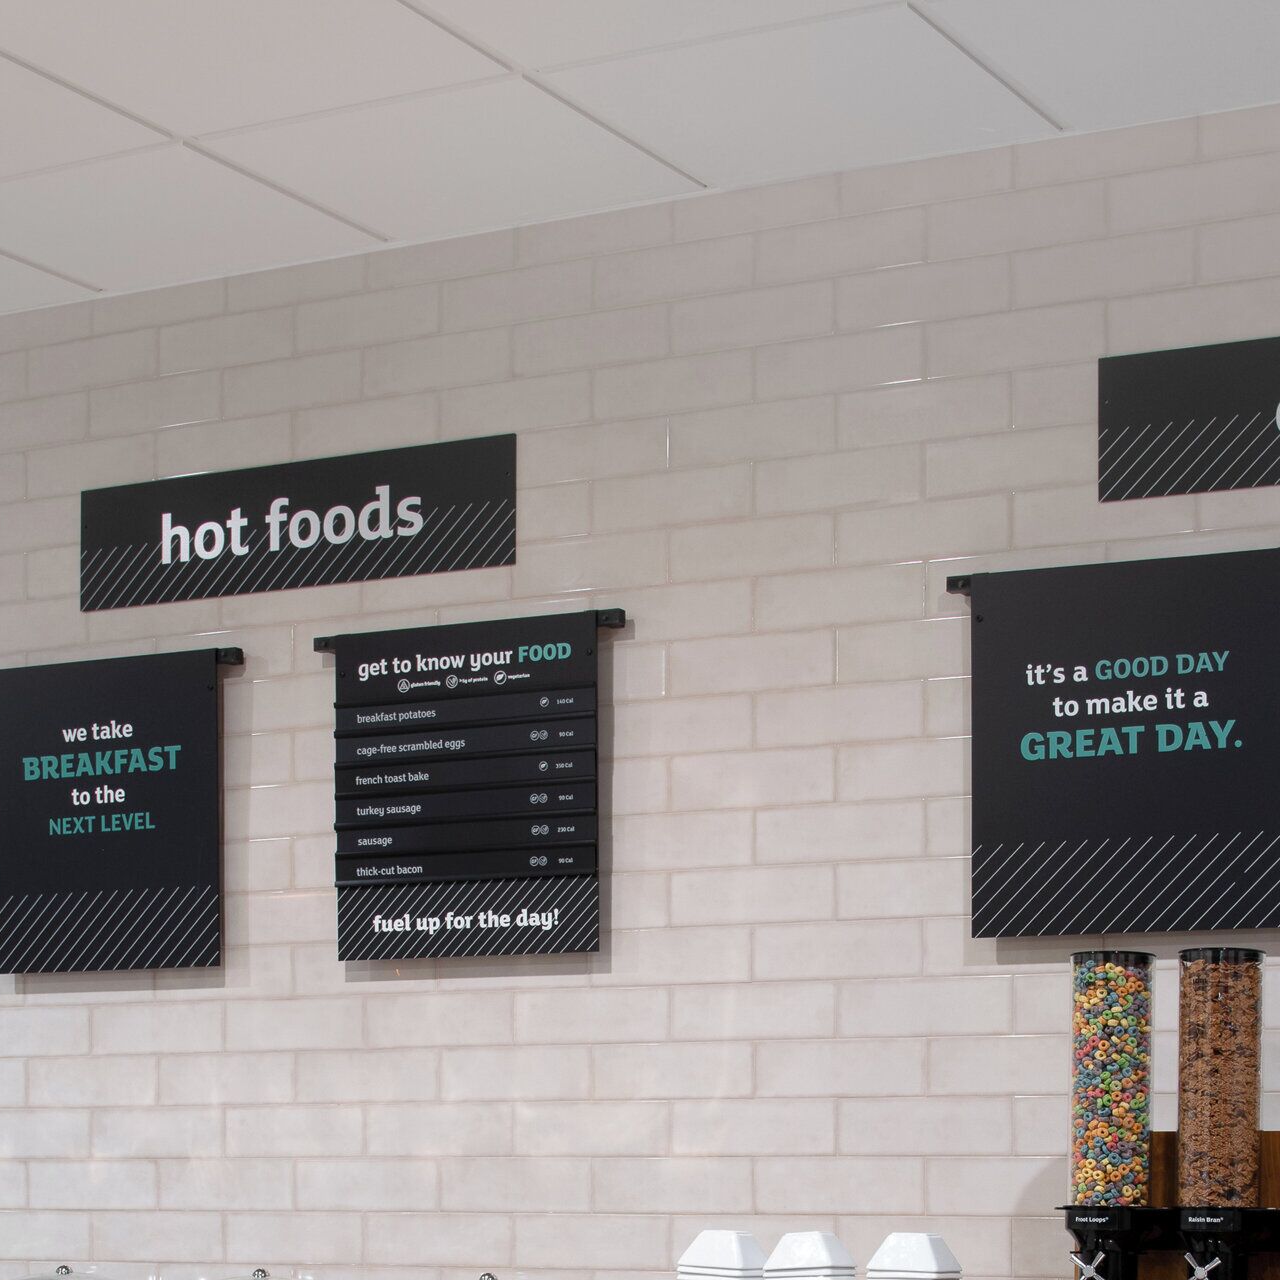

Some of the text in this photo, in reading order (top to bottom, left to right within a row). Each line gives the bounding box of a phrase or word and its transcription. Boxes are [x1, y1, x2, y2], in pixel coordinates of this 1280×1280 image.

[160, 484, 425, 565] hot foods
[358, 643, 571, 681] get to know your FOOD
[1073, 666, 1088, 682] a
[1095, 656, 1168, 680] GOOD
[1176, 651, 1229, 674] DAY
[1053, 688, 1209, 717] to make it a
[357, 710, 436, 724] breakfast potatoes
[62, 720, 133, 742] we take
[1021, 720, 1242, 760] GREAT DAY.
[357, 739, 465, 756] cage-free scrambled eggs
[23, 745, 181, 780] BREAKFAST
[356, 771, 429, 786] french toast bake
[71, 785, 125, 805] to the
[357, 804, 421, 817] turkey sausage
[50, 812, 155, 835] NEXT LEVEL
[358, 836, 392, 847] sausage
[357, 865, 422, 877] thick-cut bacon
[373, 909, 559, 935] fuel up for the day!
